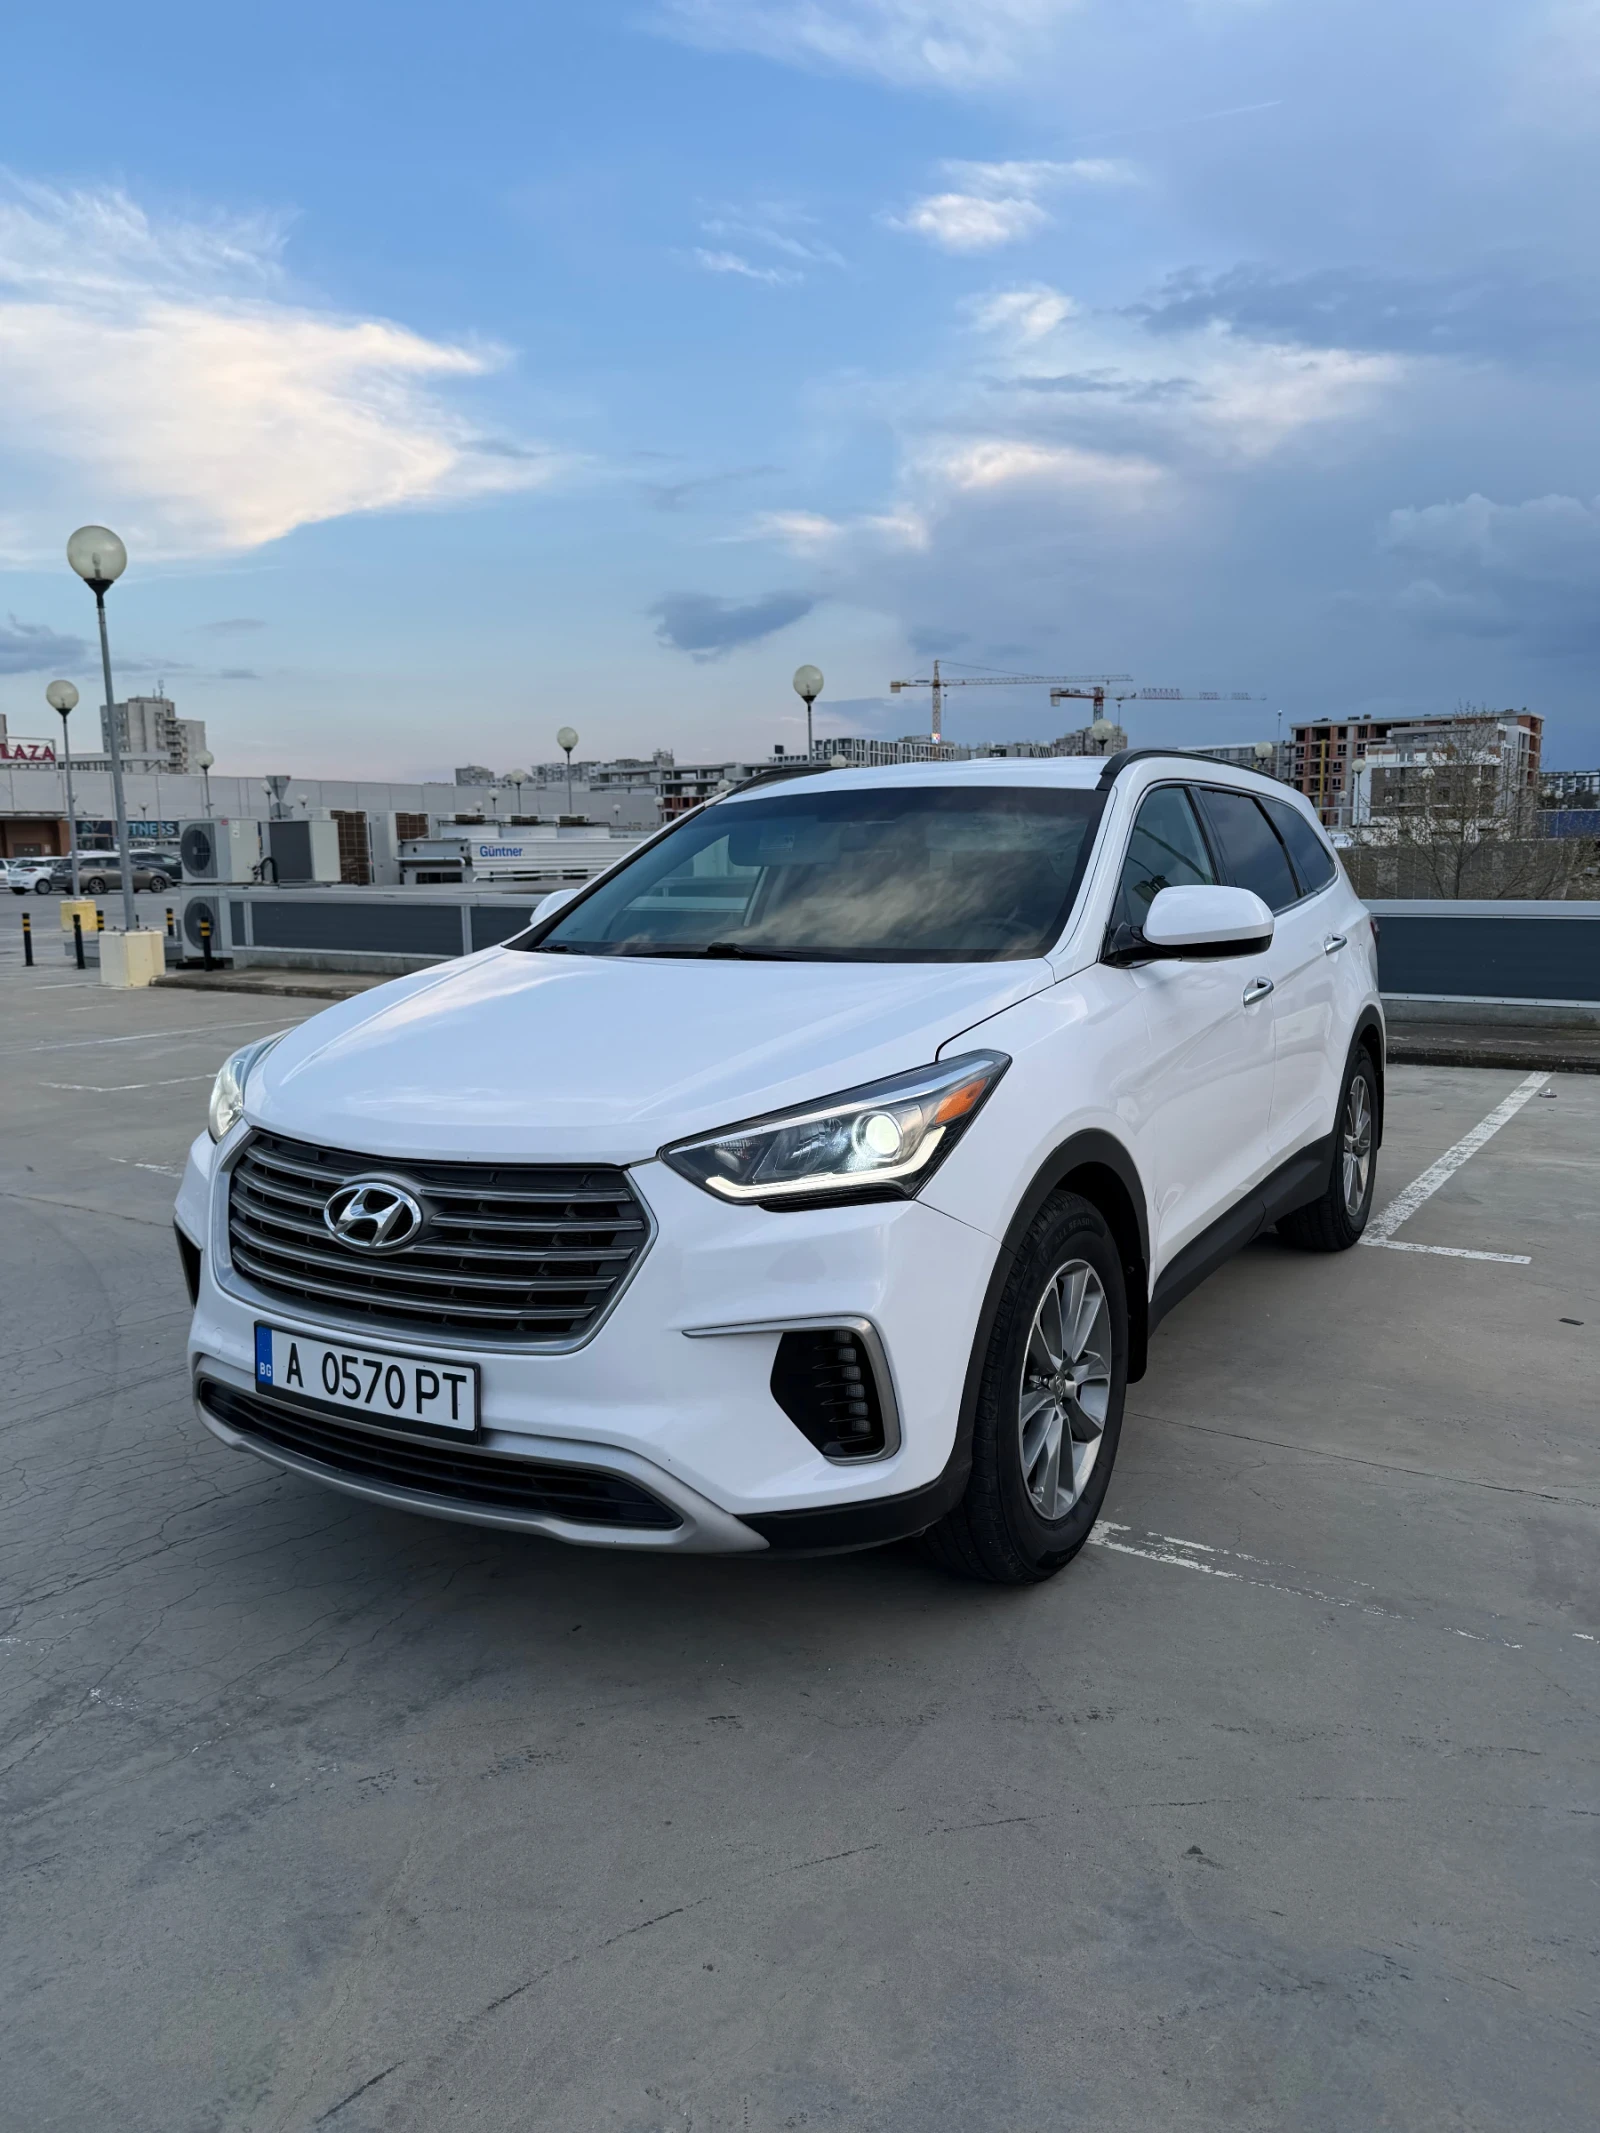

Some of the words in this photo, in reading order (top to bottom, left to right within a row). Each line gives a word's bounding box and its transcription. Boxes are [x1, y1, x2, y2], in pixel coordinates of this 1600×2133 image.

[128, 822, 175, 836] TNESS
[479, 845, 523, 858] Güntner
[259, 1361, 272, 1377] BG
[286, 1342, 304, 1388] A
[321, 1351, 406, 1410] 0570
[415, 1368, 467, 1420] PT
